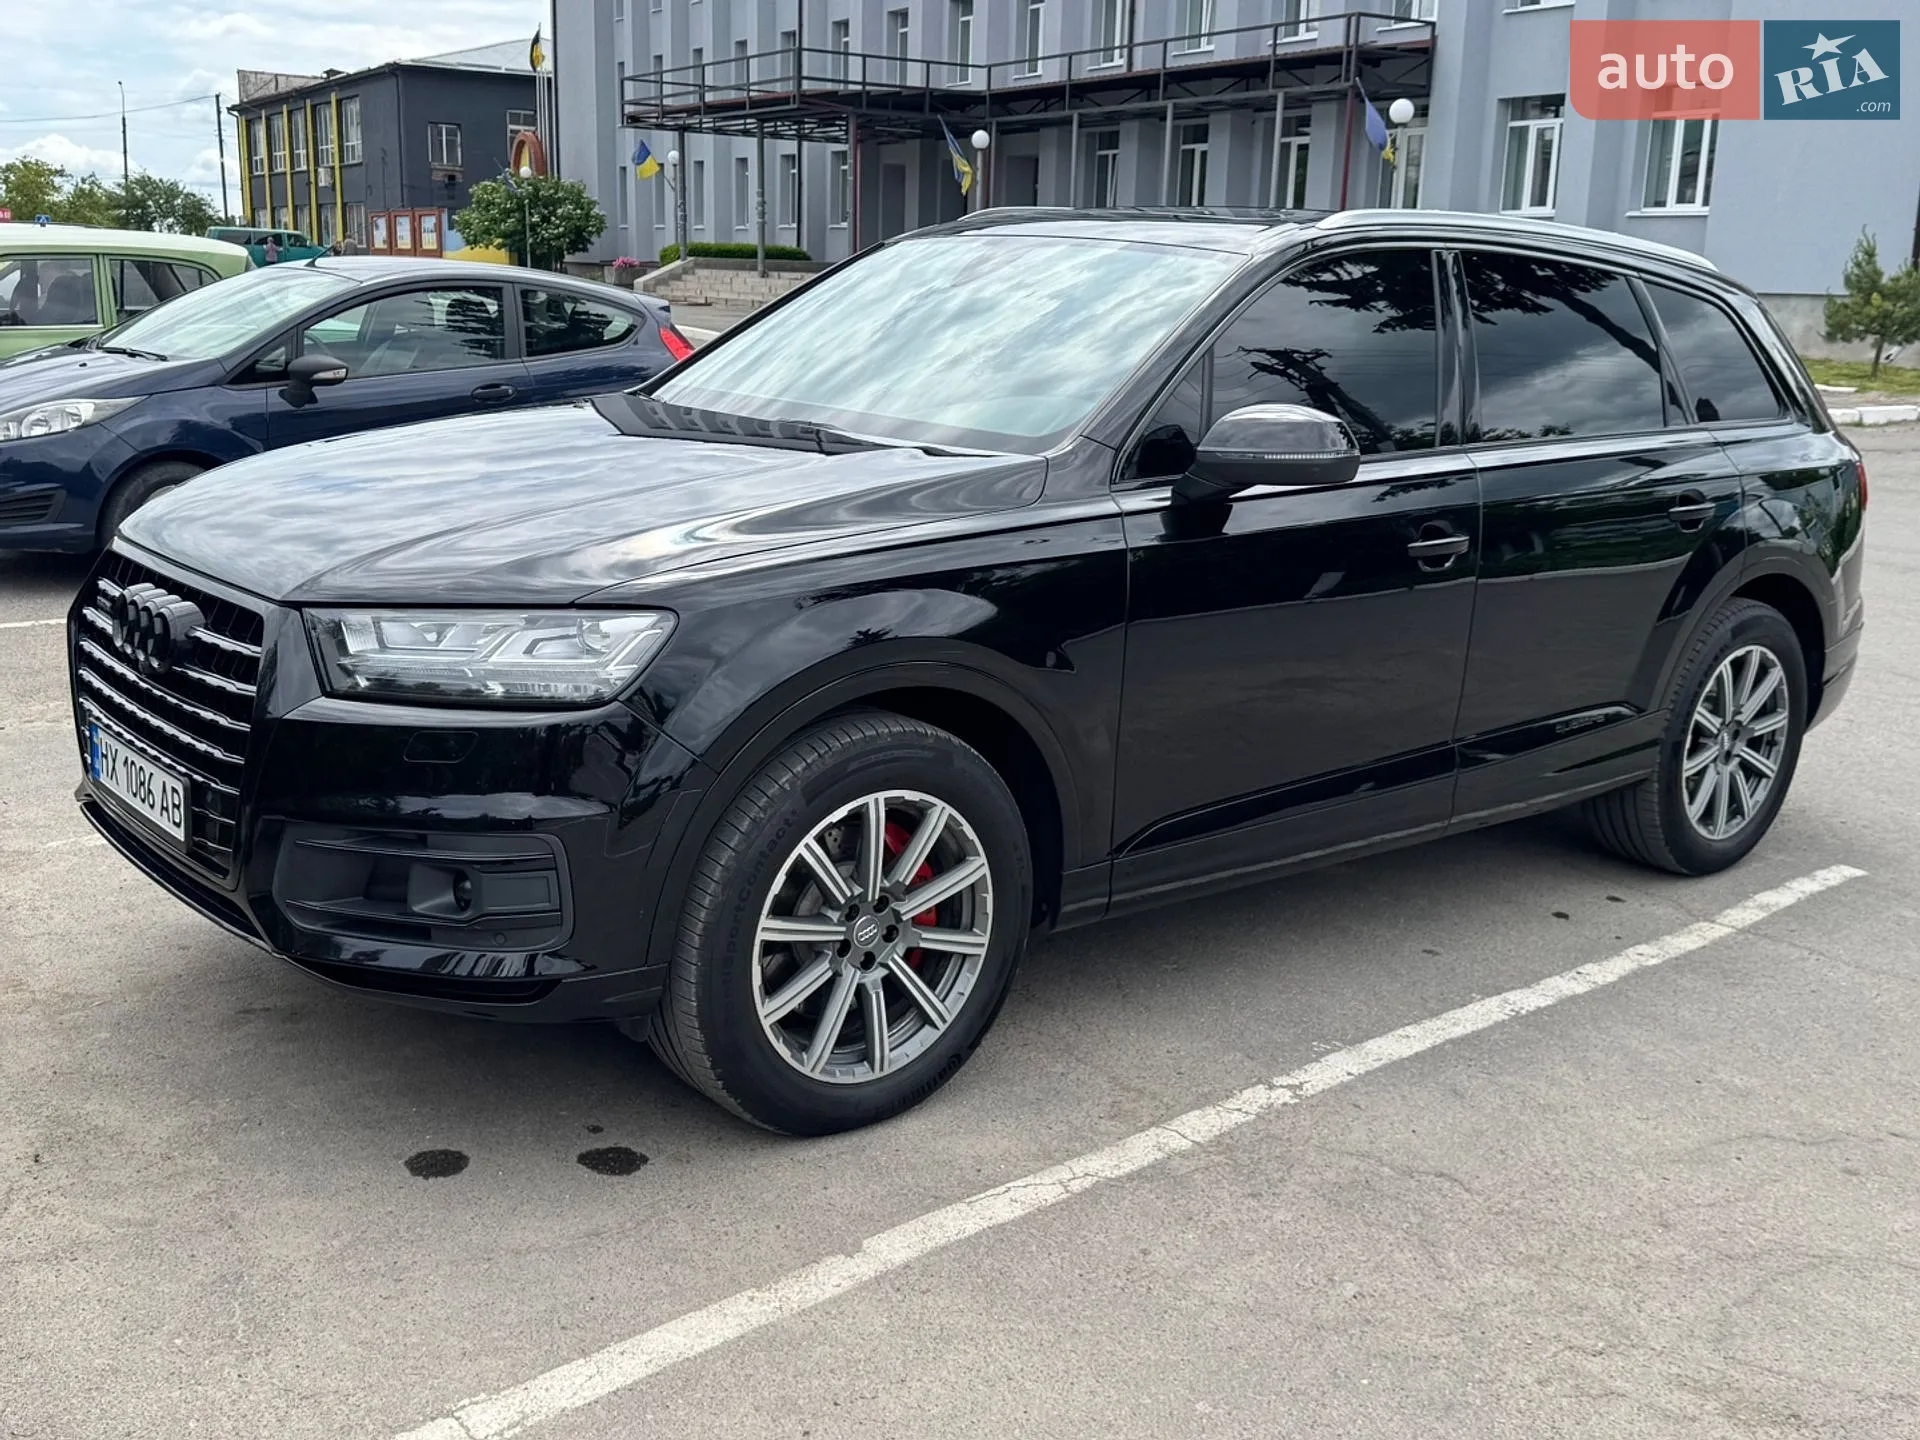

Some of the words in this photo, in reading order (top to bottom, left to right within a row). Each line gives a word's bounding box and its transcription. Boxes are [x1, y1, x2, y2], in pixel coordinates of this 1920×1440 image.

[100, 737, 119, 786] HX
[123, 756, 155, 811] 1086
[160, 780, 182, 828] AB
